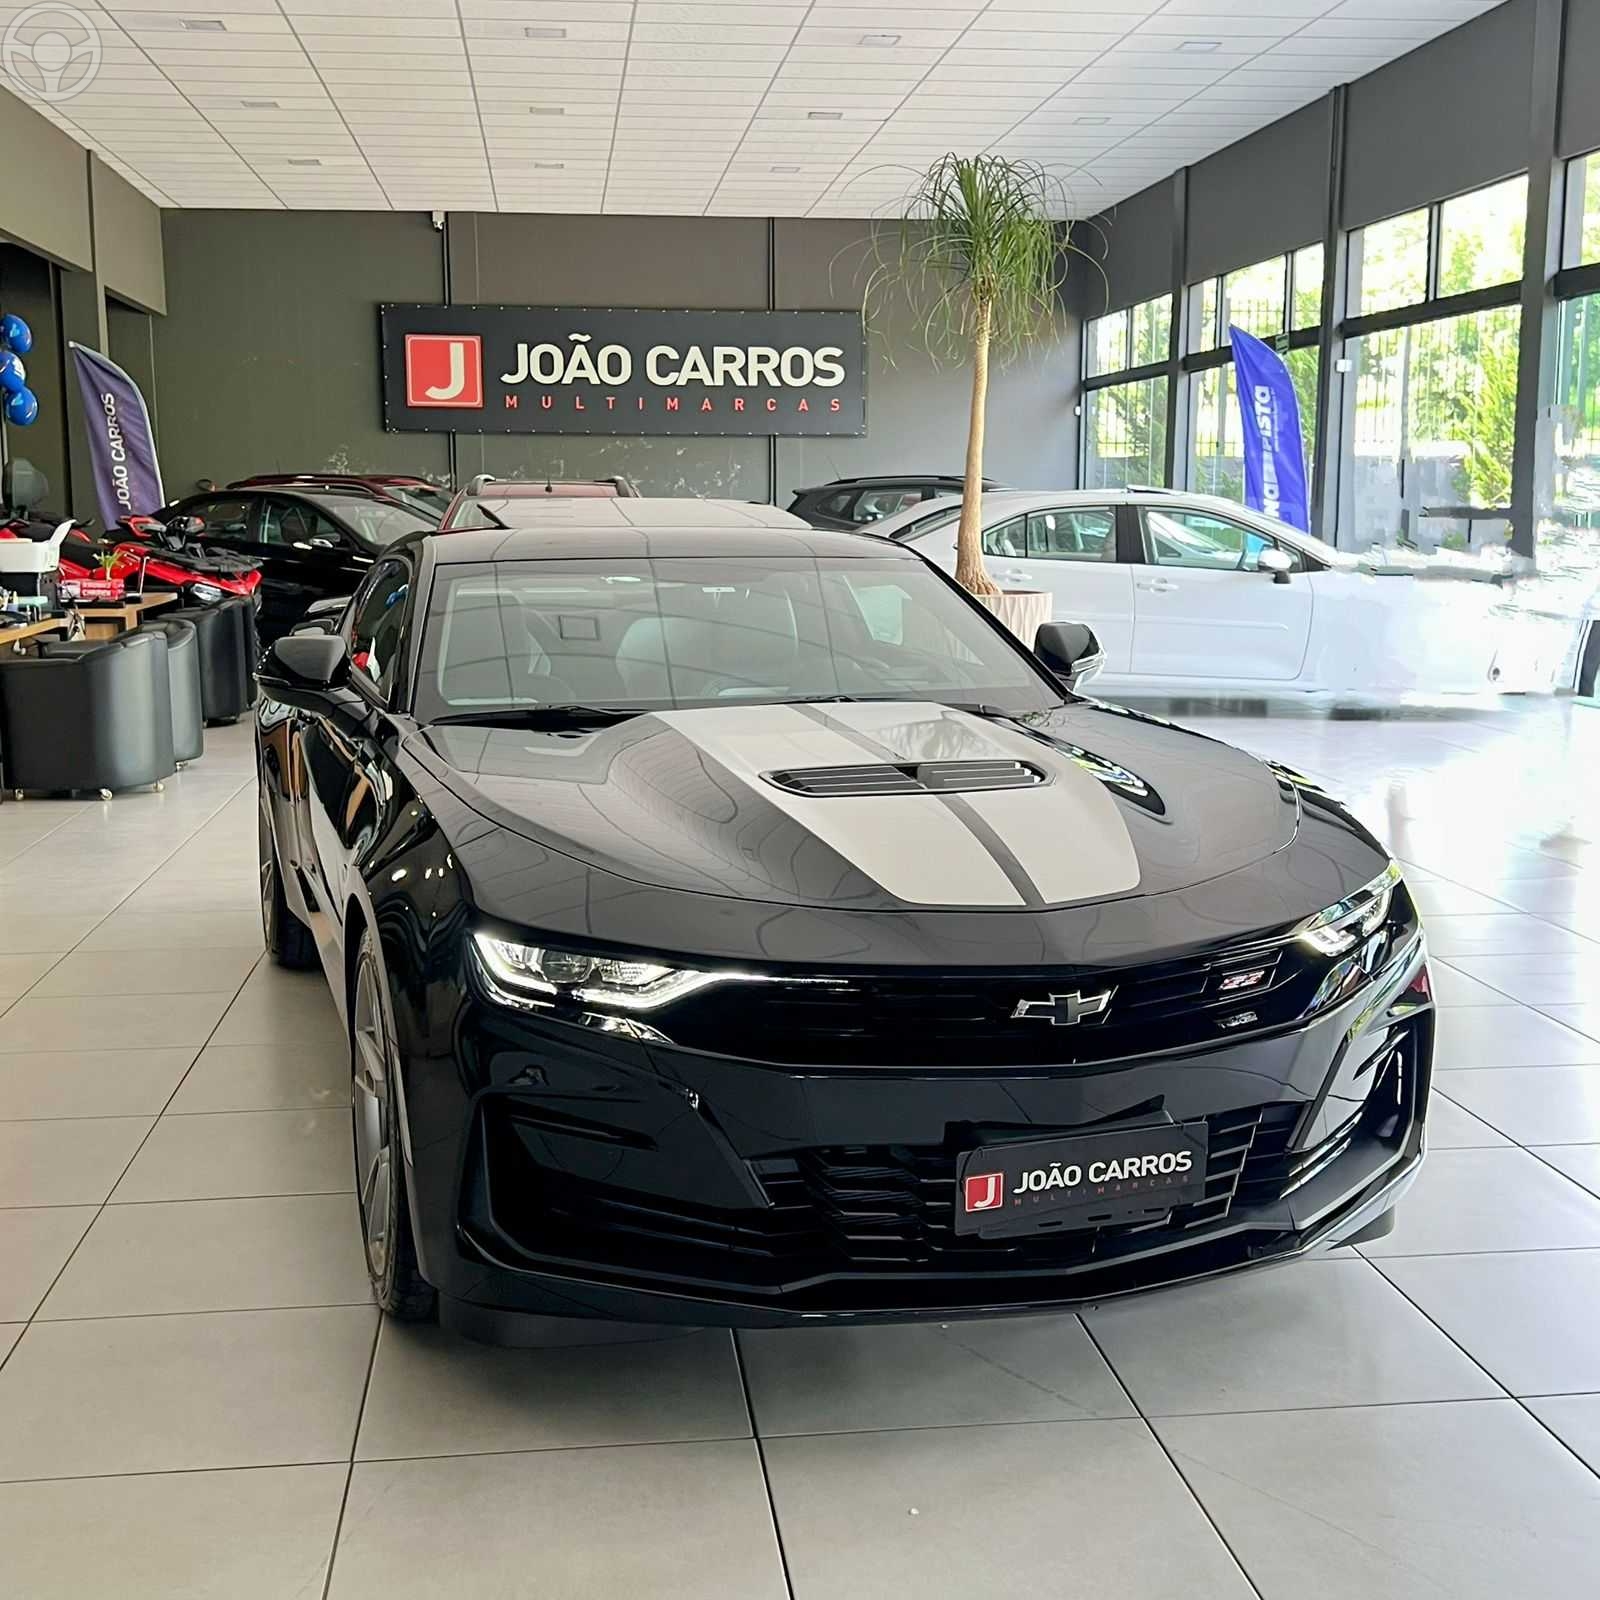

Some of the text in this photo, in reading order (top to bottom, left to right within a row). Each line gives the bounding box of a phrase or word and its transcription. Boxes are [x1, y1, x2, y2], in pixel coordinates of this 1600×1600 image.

[425, 342, 465, 400] J
[500, 333, 846, 388] JOÃO CARROS
[505, 395, 842, 412] MULTIMARCAS
[101, 392, 132, 511] JOÃO CARROS
[974, 1177, 995, 1208] J
[1013, 1150, 1193, 1194] JOÃO CARROS
